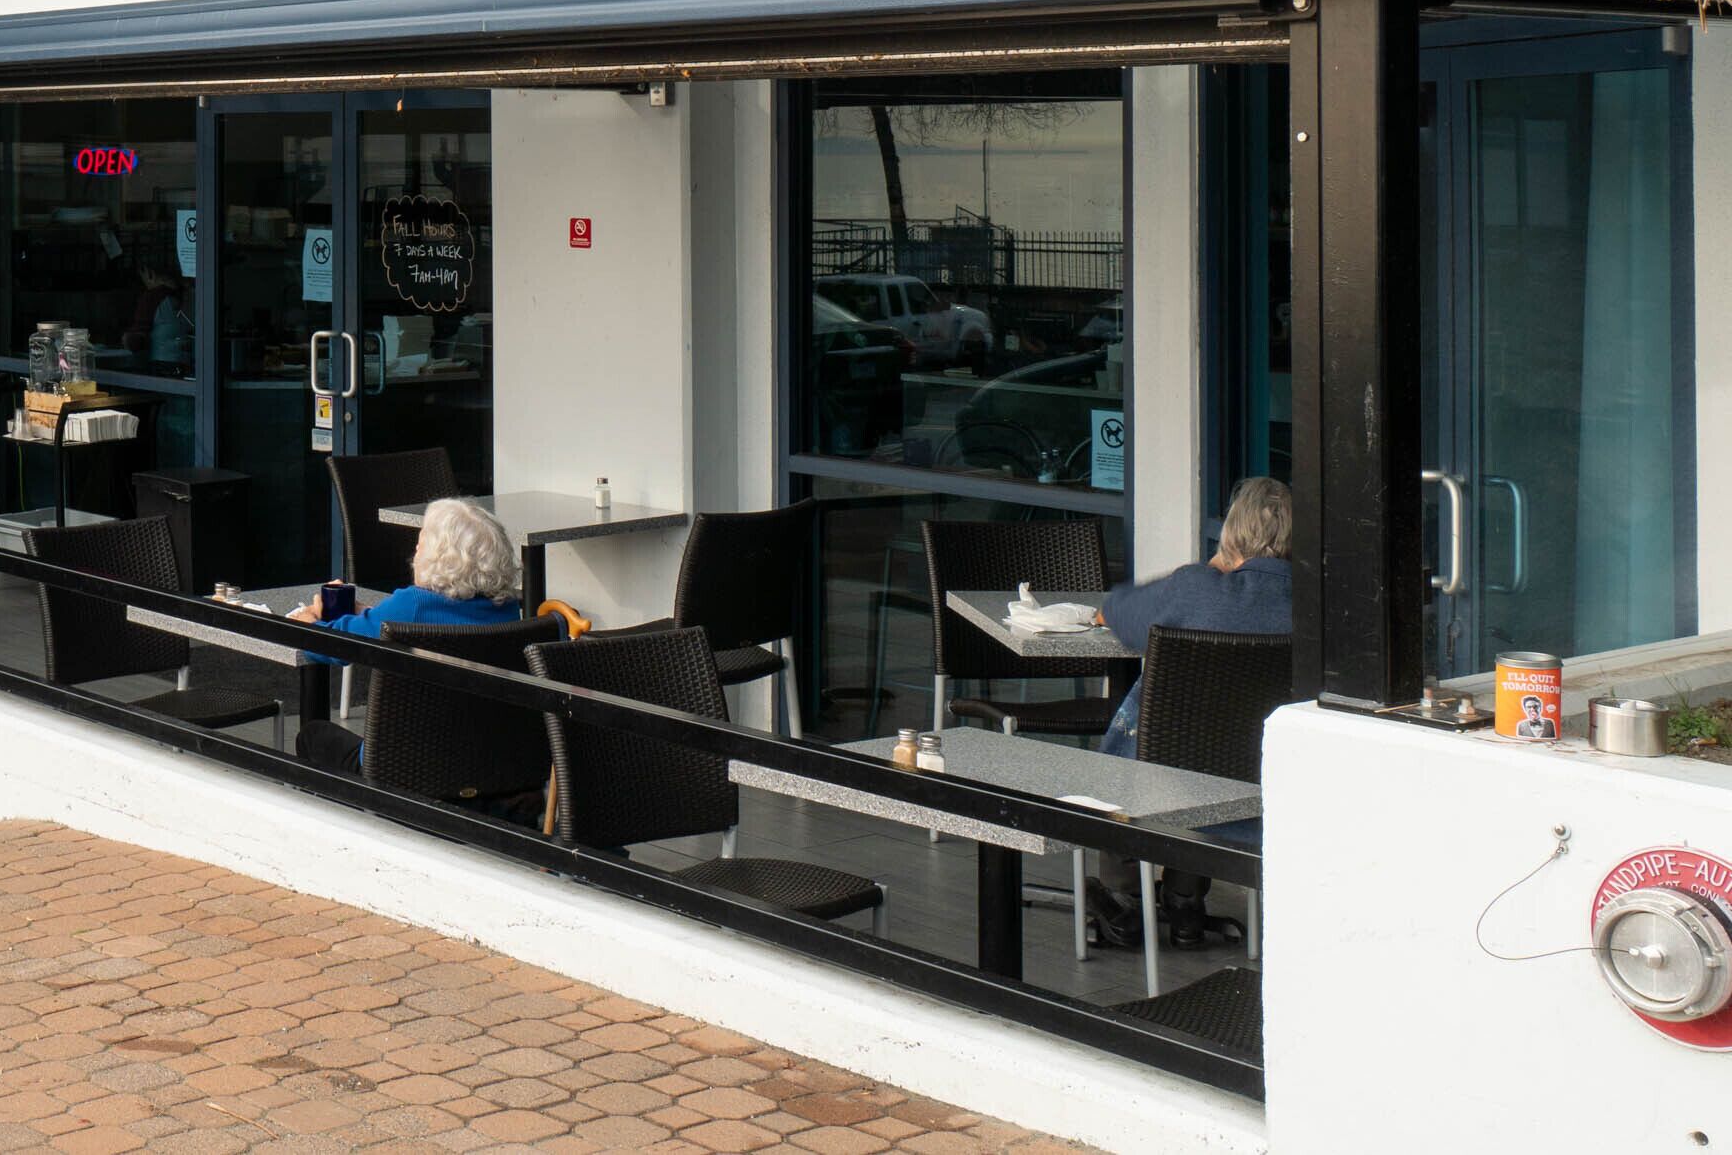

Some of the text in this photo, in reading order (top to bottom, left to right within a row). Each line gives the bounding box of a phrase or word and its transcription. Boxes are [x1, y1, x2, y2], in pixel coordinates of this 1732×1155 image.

[77, 147, 135, 175] OPEN
[393, 214, 456, 238] FALL HOURS
[393, 243, 463, 259] 7 DAYS A WEEK
[1508, 672, 1555, 684] I'LL QUIT
